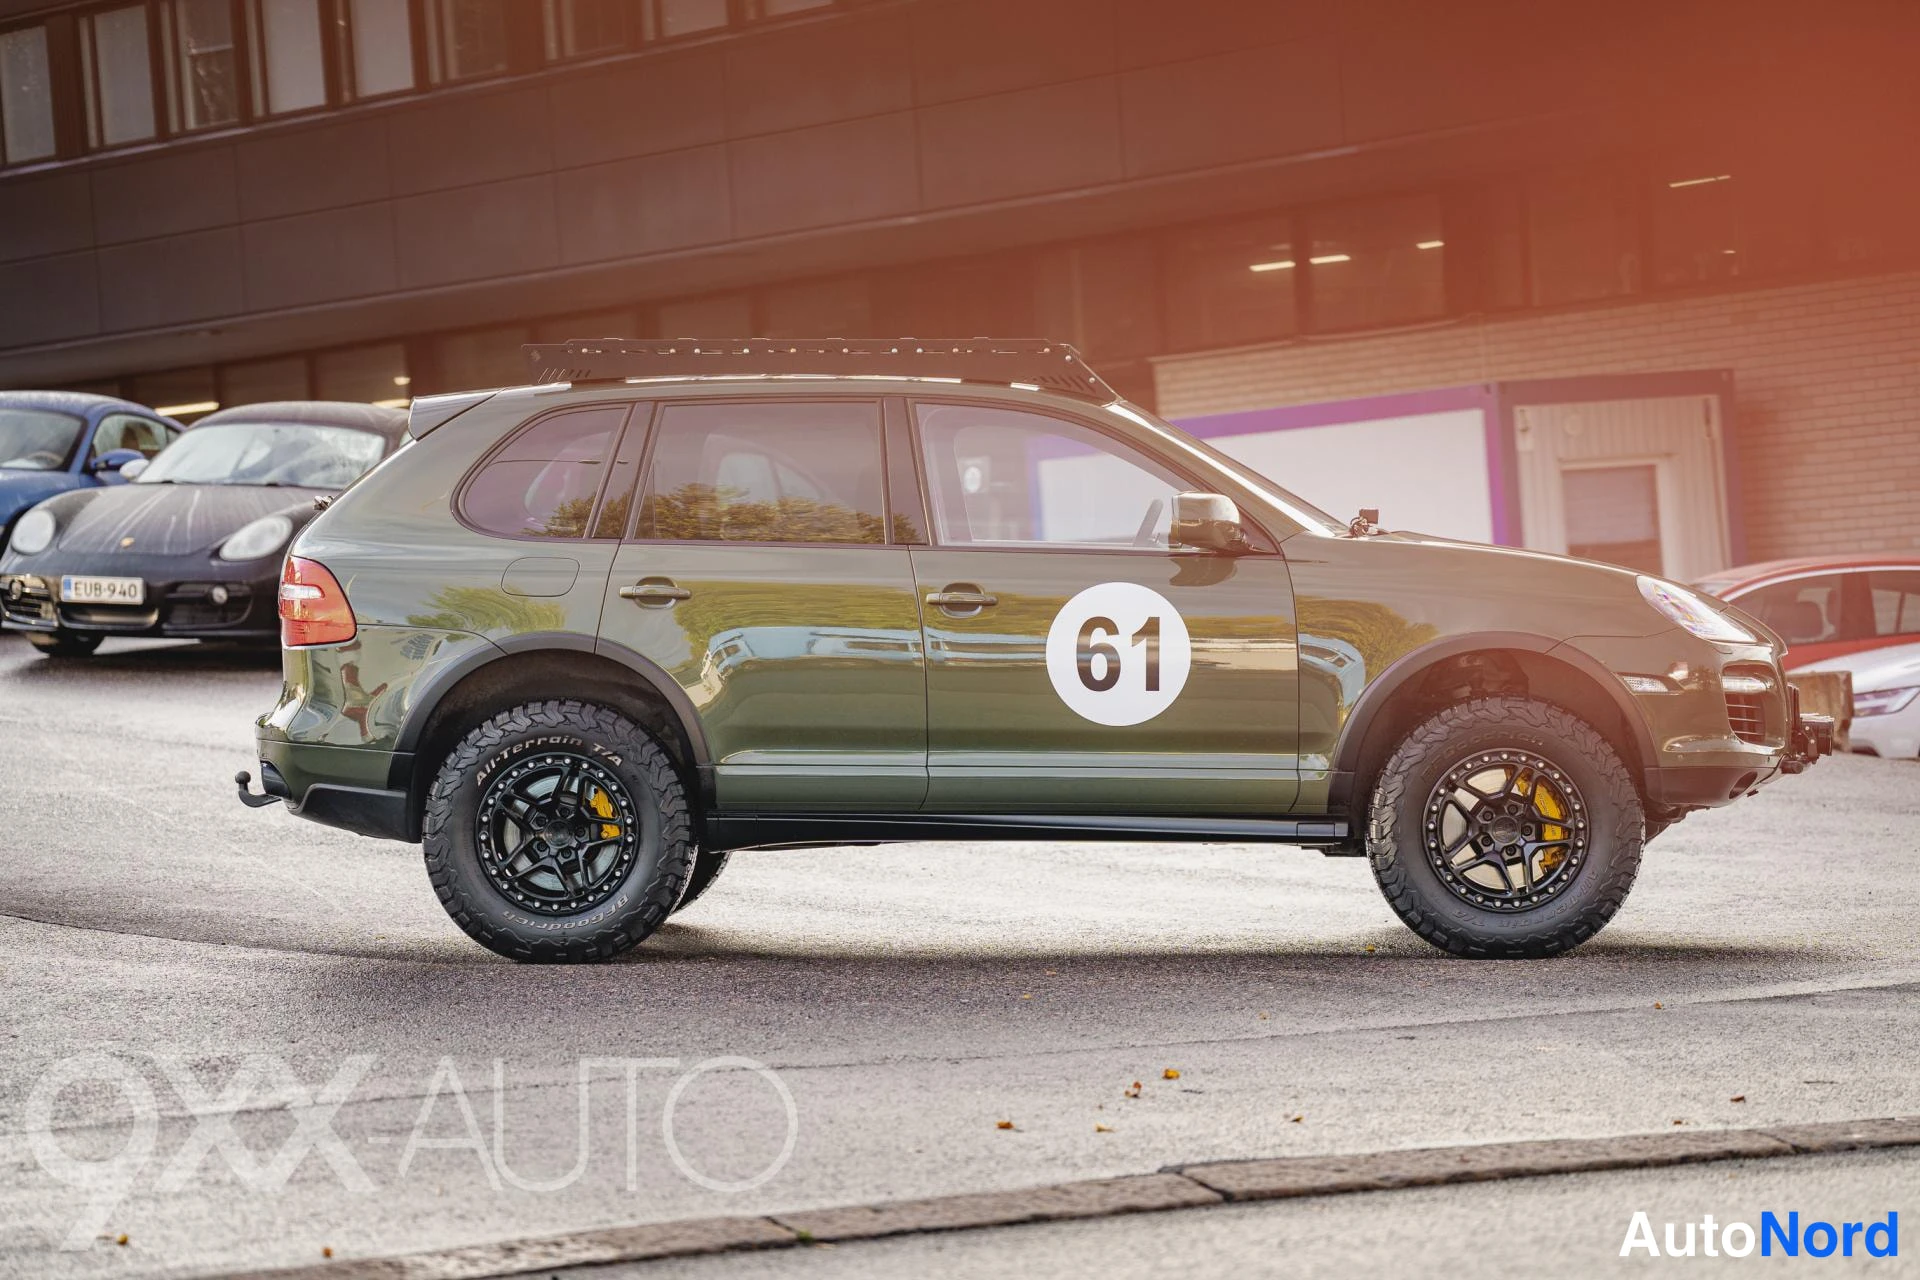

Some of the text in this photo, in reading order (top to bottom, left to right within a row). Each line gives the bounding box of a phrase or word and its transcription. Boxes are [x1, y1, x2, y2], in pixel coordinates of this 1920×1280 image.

[74, 581, 138, 599] EUB-940
[1076, 616, 1160, 692] 61
[475, 735, 625, 786] All-Terrain T/A
[502, 894, 629, 931] BFGoodrich
